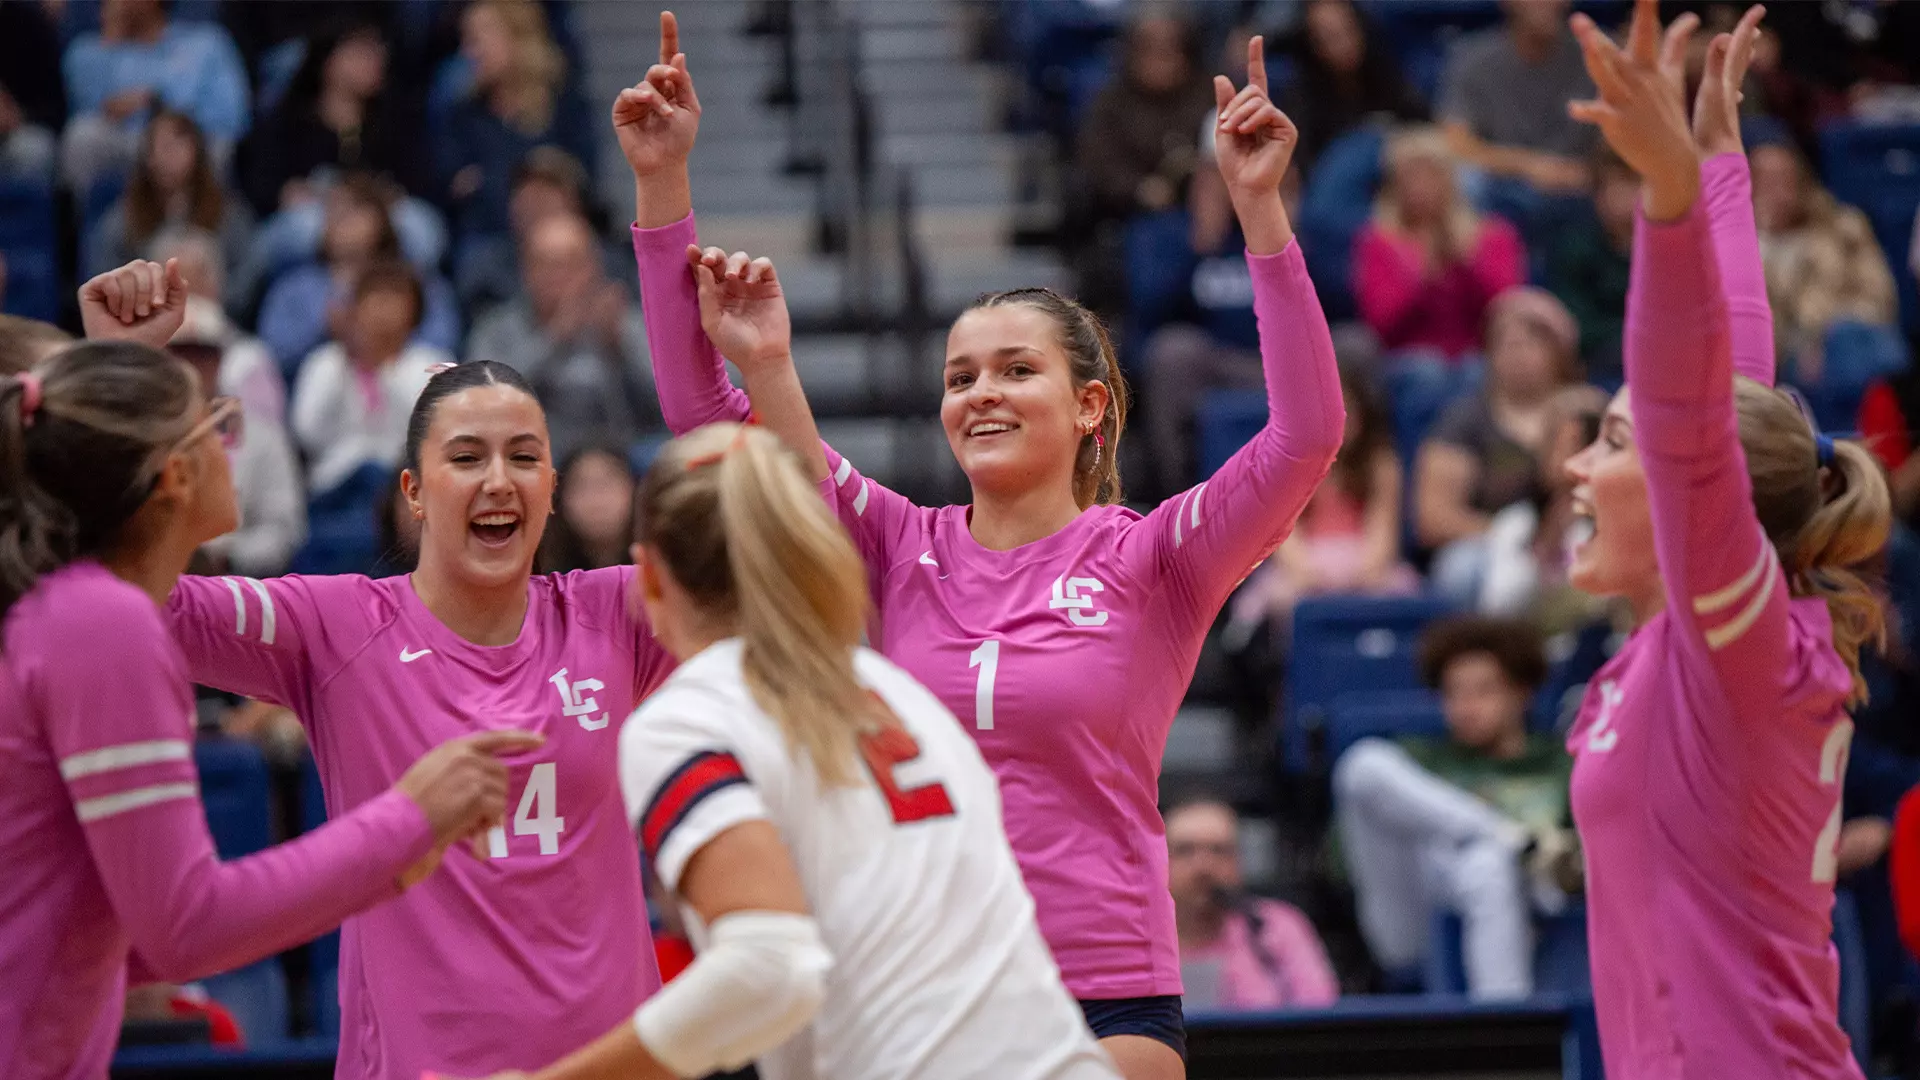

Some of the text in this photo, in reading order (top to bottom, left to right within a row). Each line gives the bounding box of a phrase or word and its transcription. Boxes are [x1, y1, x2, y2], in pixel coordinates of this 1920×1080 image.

[1048, 574, 1109, 626] LC
[549, 667, 610, 732] LC
[968, 640, 1000, 730] 1
